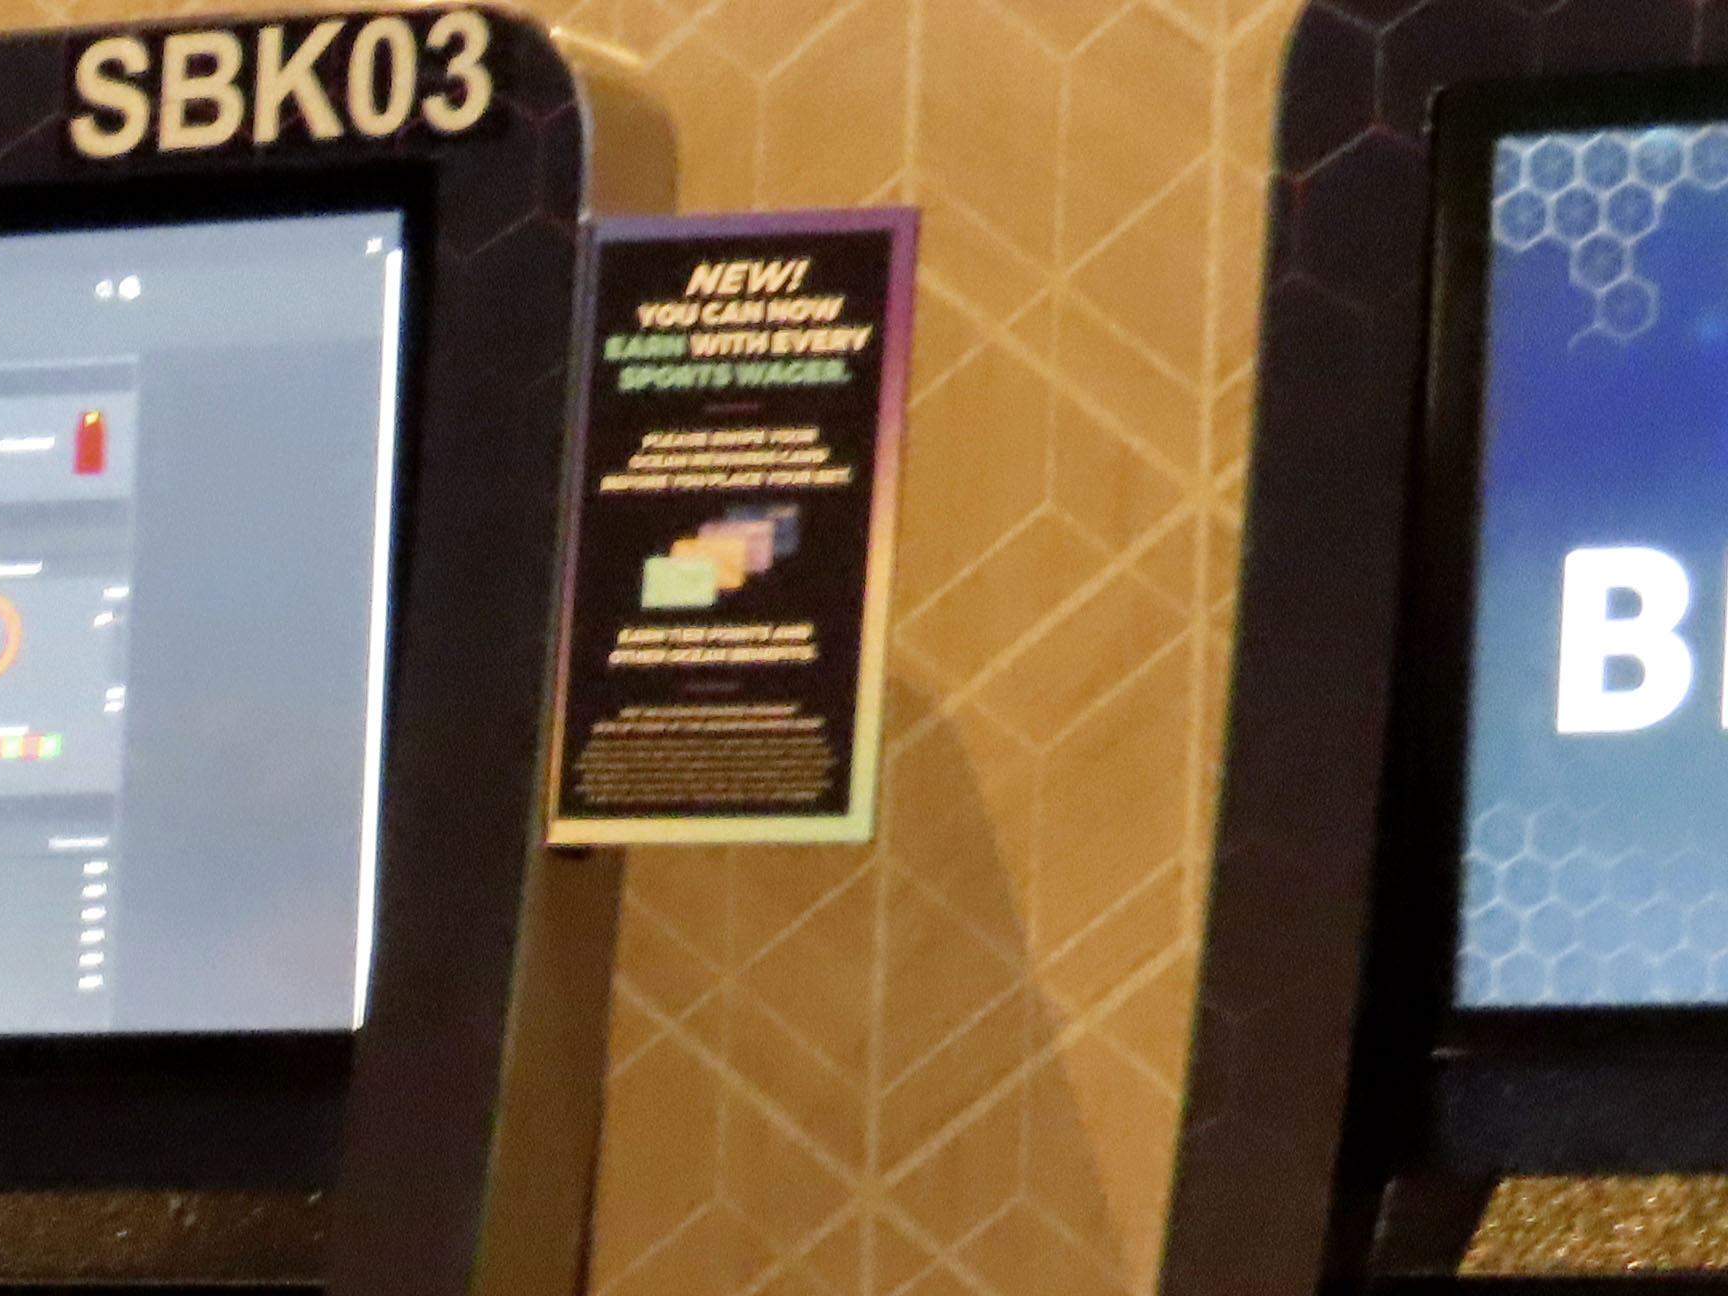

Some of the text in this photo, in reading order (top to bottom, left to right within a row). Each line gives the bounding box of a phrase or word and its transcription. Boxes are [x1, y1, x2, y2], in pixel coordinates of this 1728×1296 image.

[69, 9, 493, 160] SBK03
[686, 257, 810, 296] NEW!
[1557, 547, 1728, 734] B
